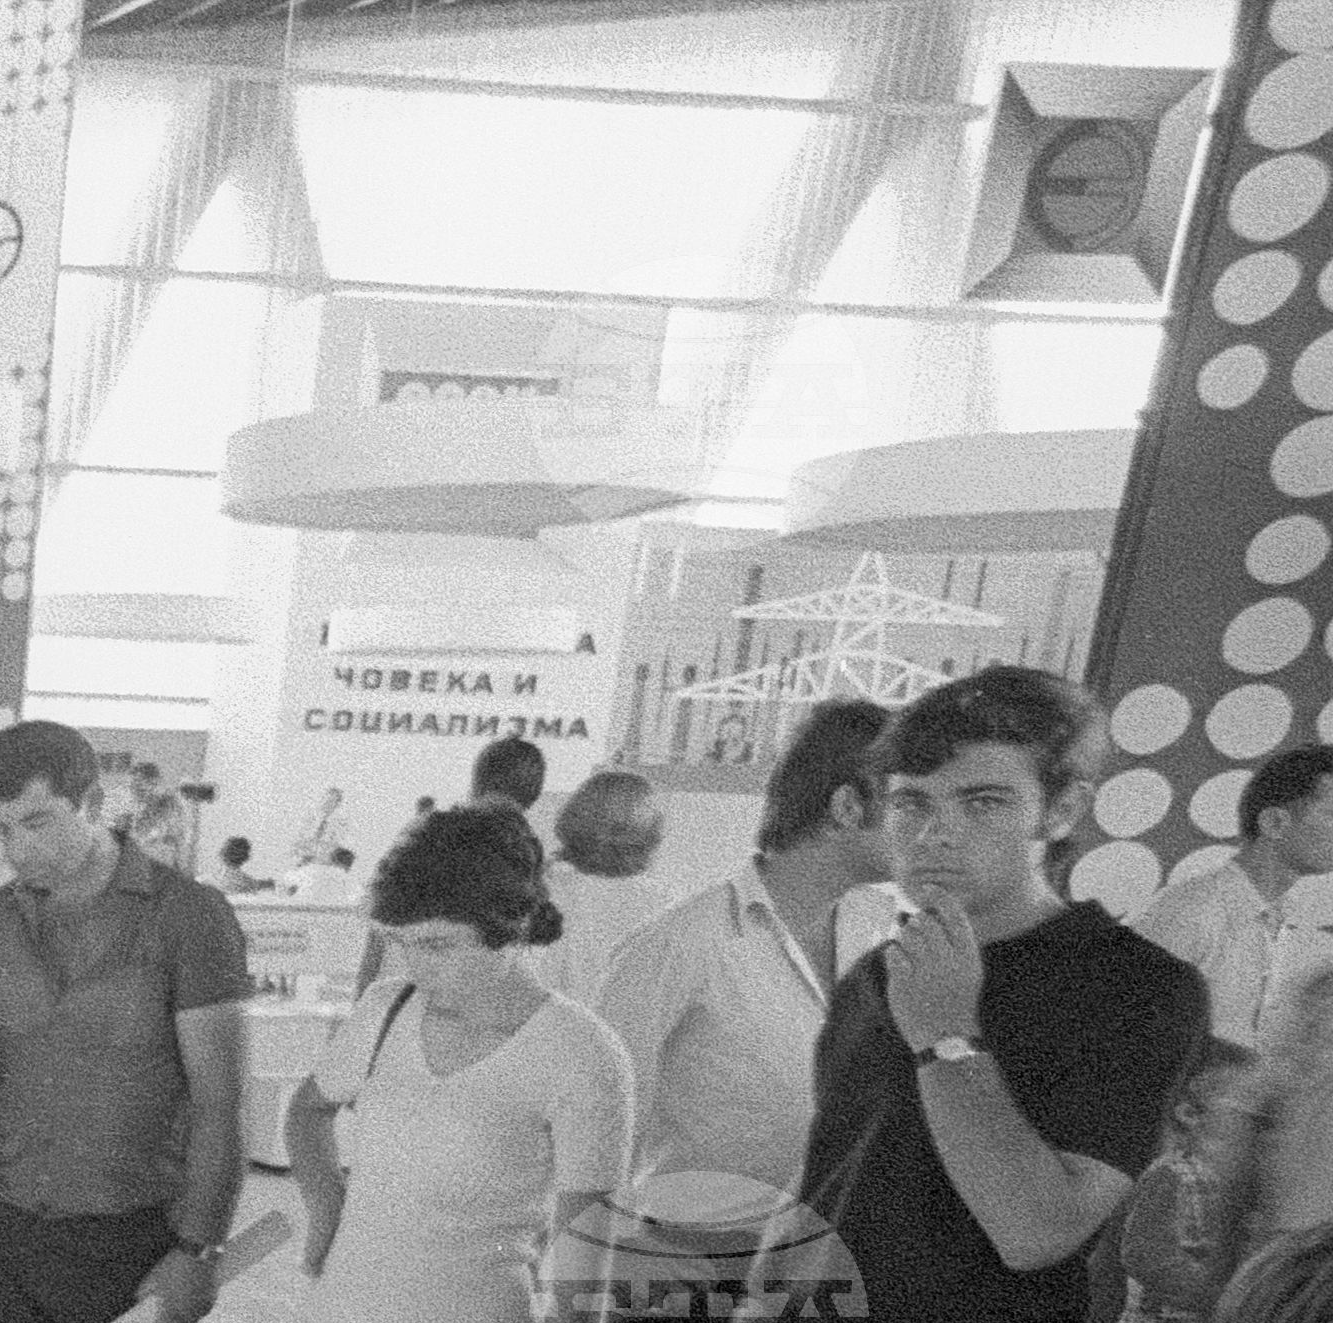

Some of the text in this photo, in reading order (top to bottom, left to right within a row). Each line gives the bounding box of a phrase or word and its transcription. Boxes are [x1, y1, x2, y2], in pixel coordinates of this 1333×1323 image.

[333, 665, 539, 696] ЧОВЕКА И
[302, 707, 590, 739] СОЦИАЛИЗМА
